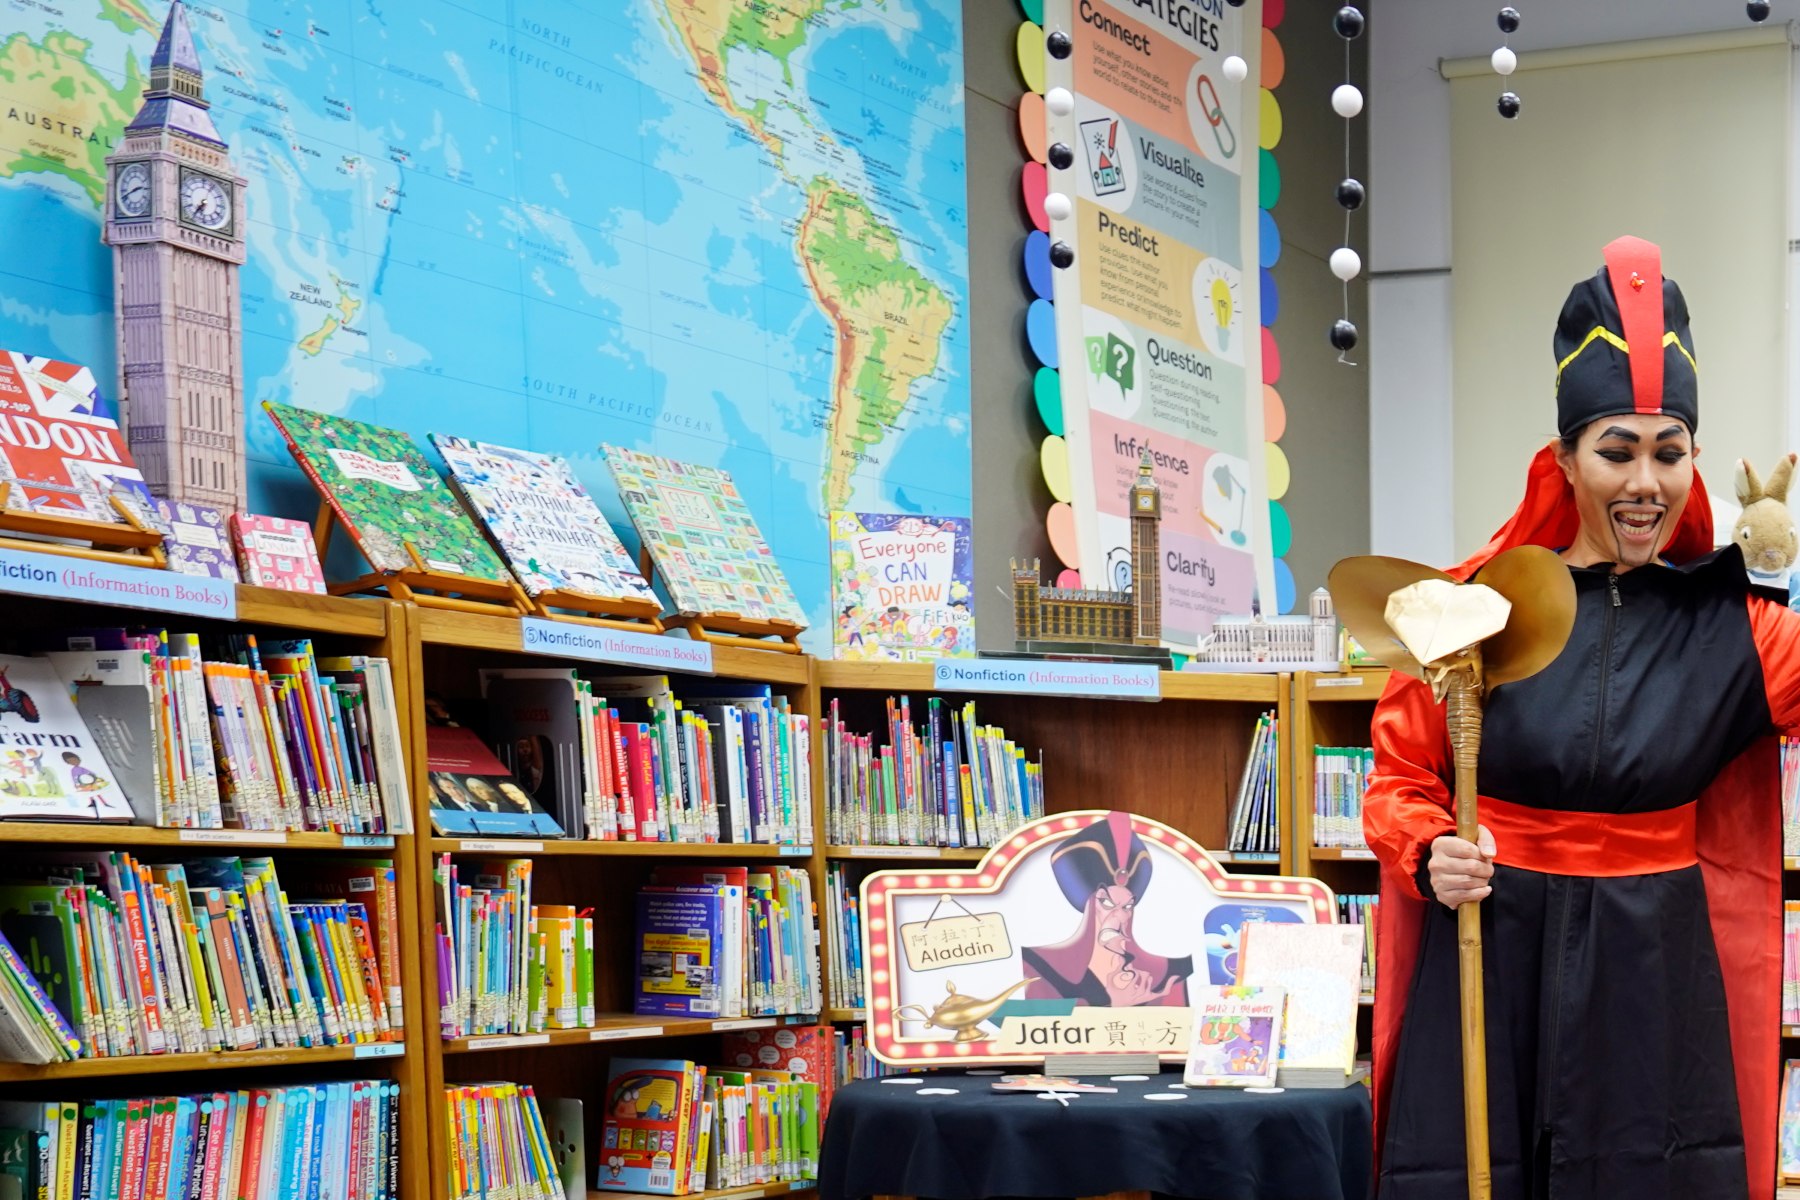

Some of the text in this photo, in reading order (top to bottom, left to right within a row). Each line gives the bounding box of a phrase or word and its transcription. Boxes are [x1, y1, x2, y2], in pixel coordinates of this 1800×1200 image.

[744, 1, 781, 23] AMERICA
[520, 17, 573, 49] NORTH
[1079, 0, 1151, 57] Connect
[488, 38, 605, 95] PACIFIC OCEAN
[891, 57, 928, 79] NORTH
[1139, 137, 1205, 188] Visualize
[1098, 211, 1159, 257] Predict
[289, 291, 333, 310] ZEALAND
[300, 282, 321, 296] NEW
[883, 311, 910, 327] BRAZIL
[1147, 338, 1212, 381] Question
[521, 375, 714, 433] SOUTH PACIFIC OCEAN
[813, 419, 834, 432] CHILE
[338, 450, 401, 472] ELEPHANTS
[840, 449, 880, 465] ARGENTINA
[1114, 432, 1190, 476] Infeence
[497, 486, 577, 515] EVERYTHING
[665, 487, 701, 501] CITY
[672, 503, 710, 520] ATLAS
[513, 523, 600, 549] EVERYWHERE
[858, 537, 948, 563] Everyone
[884, 562, 928, 584] CAN
[1166, 550, 1216, 588] Clarify
[61, 568, 170, 599] (Information
[175, 583, 229, 609] Books)
[878, 583, 942, 607] DRAW
[538, 628, 708, 666] Nonfiction (Information Books)
[954, 665, 1155, 689] Nonfiction (Information Books)
[920, 940, 994, 963] Aladdin
[1015, 1021, 1096, 1048] Jafar
[374, 1046, 387, 1055] E-6
